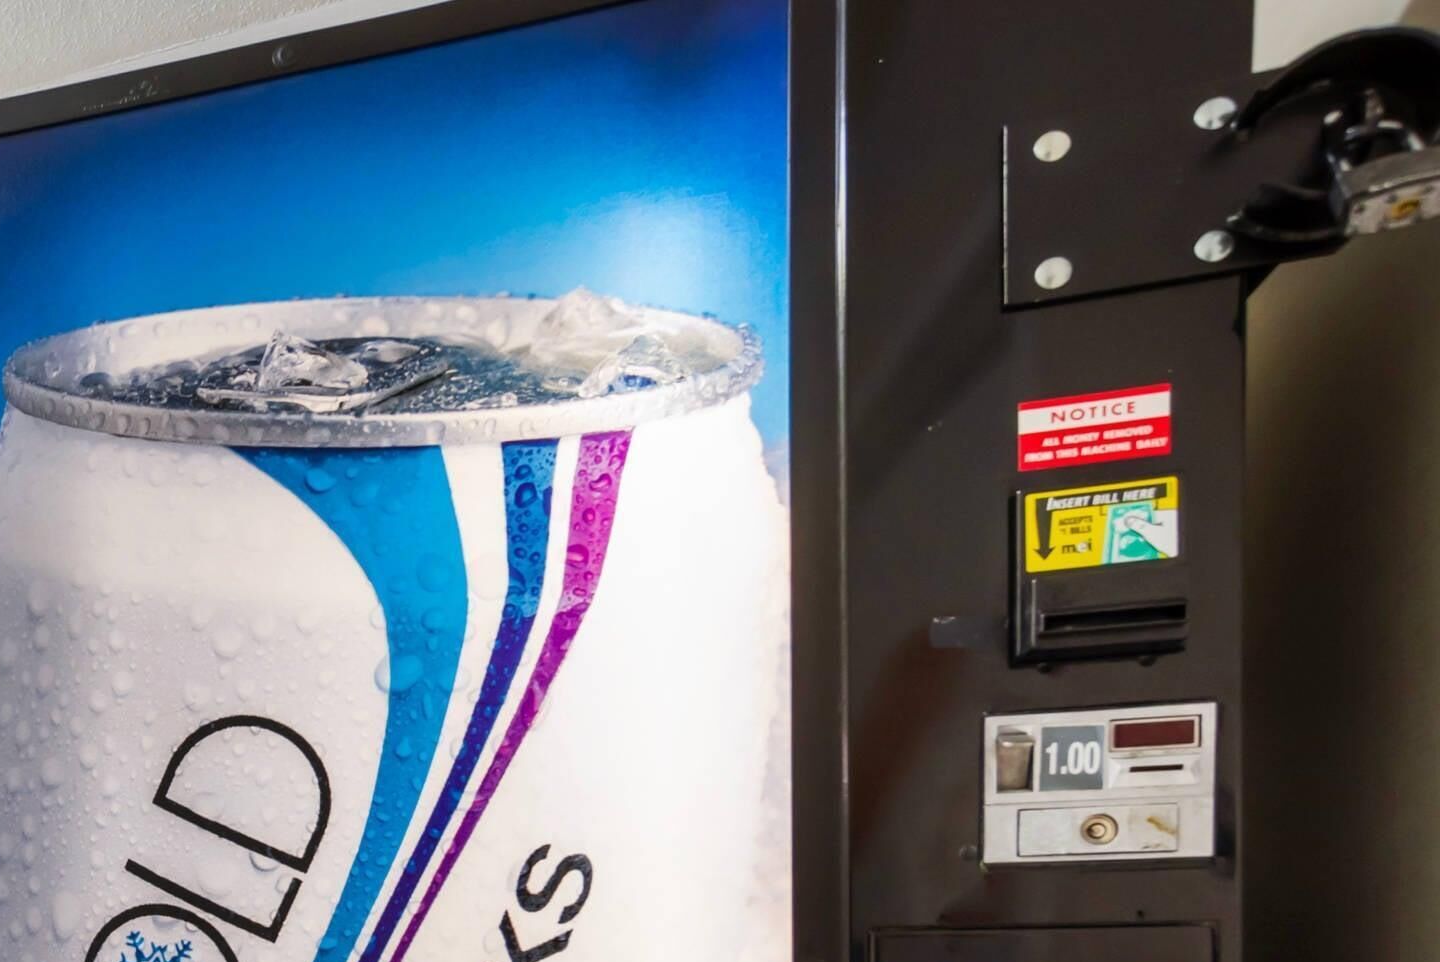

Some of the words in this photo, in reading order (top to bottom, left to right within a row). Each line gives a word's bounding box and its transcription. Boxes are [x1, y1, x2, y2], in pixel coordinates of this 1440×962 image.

[1051, 401, 1136, 424] NOTICE
[1046, 496, 1092, 511] INSERT
[1092, 492, 1119, 505] BILL
[1122, 487, 1157, 501] HERE
[1044, 740, 1101, 776] 1.00
